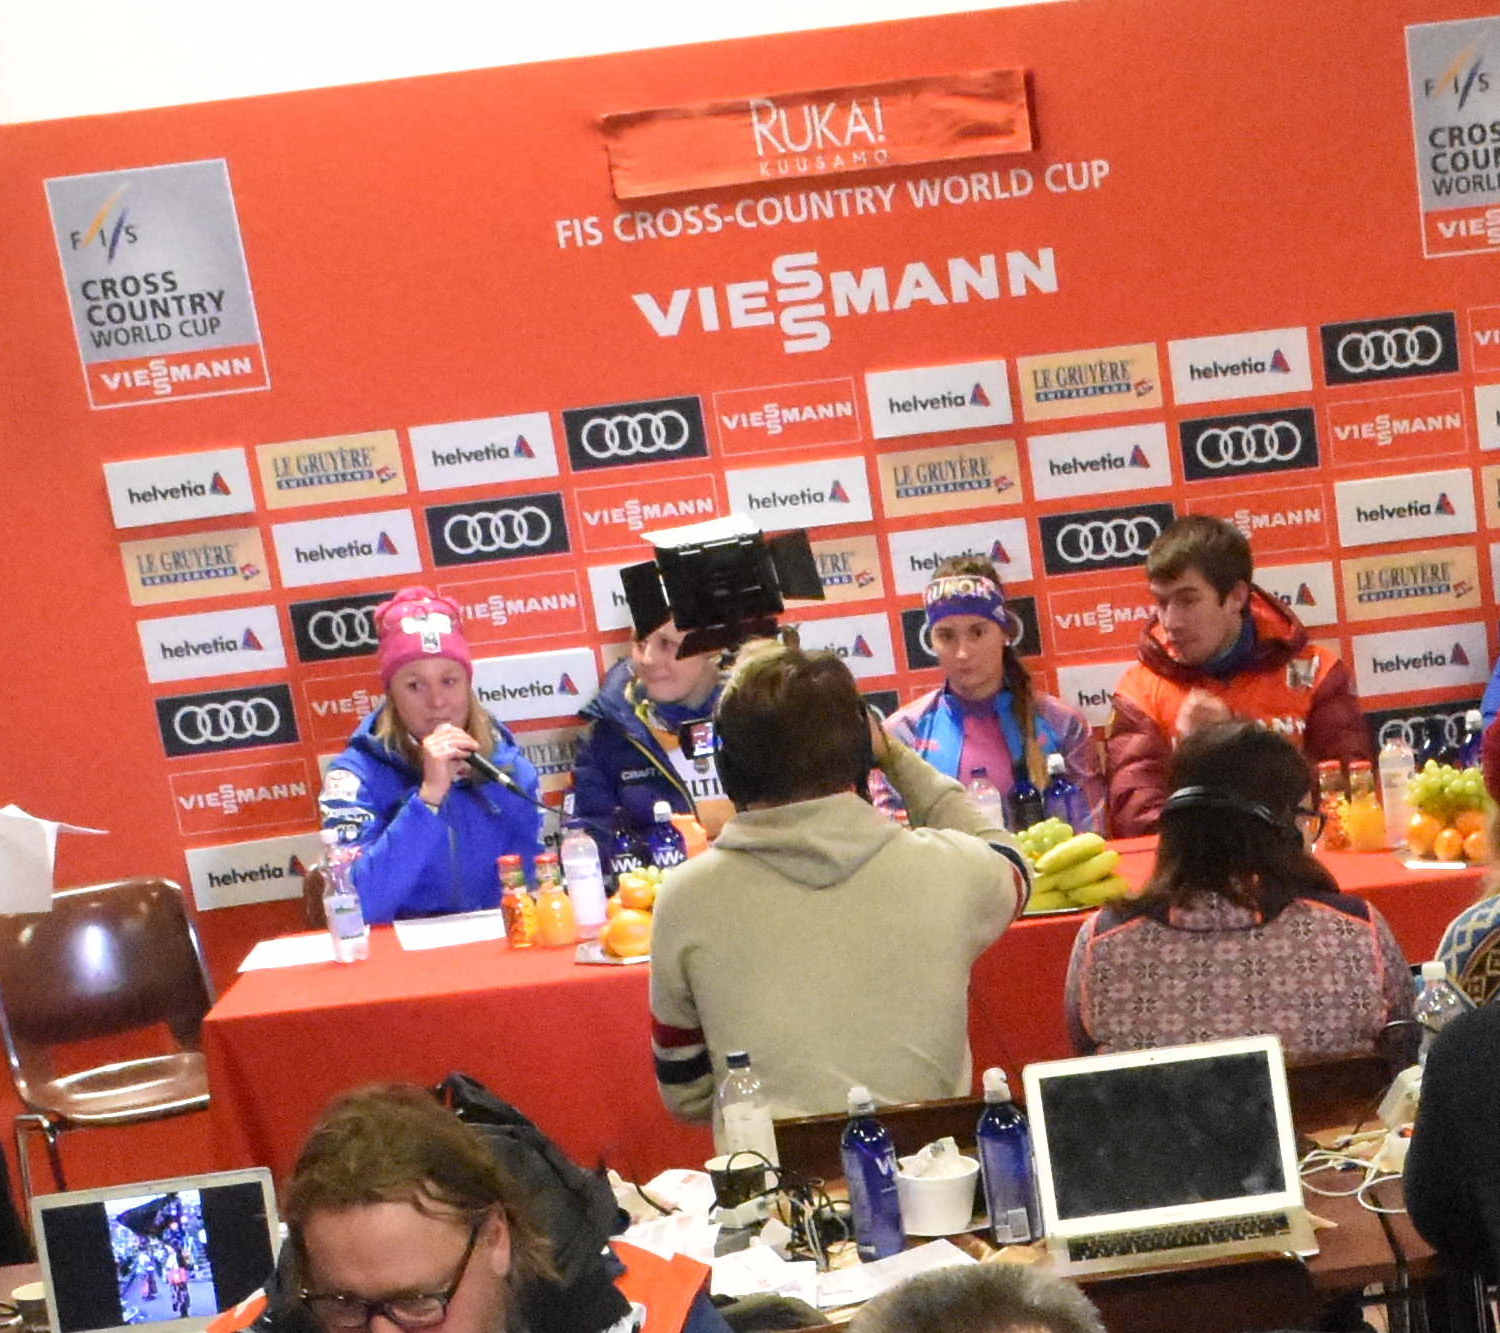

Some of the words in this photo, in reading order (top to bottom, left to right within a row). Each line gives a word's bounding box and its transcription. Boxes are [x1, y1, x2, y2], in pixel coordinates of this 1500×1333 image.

[750, 97, 886, 157] RUKA!
[760, 149, 890, 177] KUUSAMO
[555, 216, 604, 250] FIS
[613, 183, 896, 243] CROSS-COUNTRY
[908, 168, 1035, 208] WORLD
[1045, 159, 1111, 192] CUP
[81, 271, 178, 303] CROSS
[632, 248, 1059, 354] VIESSMANN
[86, 291, 226, 328] COUNTRY
[90, 321, 172, 350] WORLD
[179, 316, 222, 339] CUP
[101, 358, 253, 396] VIESSMANN
[1188, 355, 1266, 382] helvetia
[887, 391, 967, 416] helvetia
[721, 402, 853, 436] VIESSMANN
[1333, 412, 1461, 446] VIESSMANN
[431, 443, 511, 468] helvetia
[1048, 453, 1126, 478] helvetia
[128, 480, 206, 505] helvetia
[748, 487, 825, 511] helvetia
[582, 497, 714, 531] VIESSMANN
[1233, 507, 1321, 541] SSMANN
[1356, 497, 1432, 524] helvetia
[295, 539, 374, 566] helvetia
[465, 593, 579, 628] IESSMANN
[159, 635, 238, 661] helvetia
[1371, 649, 1448, 675] helvetia
[478, 679, 554, 705] helvetia
[178, 784, 307, 815] VIESSMANN
[207, 862, 285, 889] helvetia
